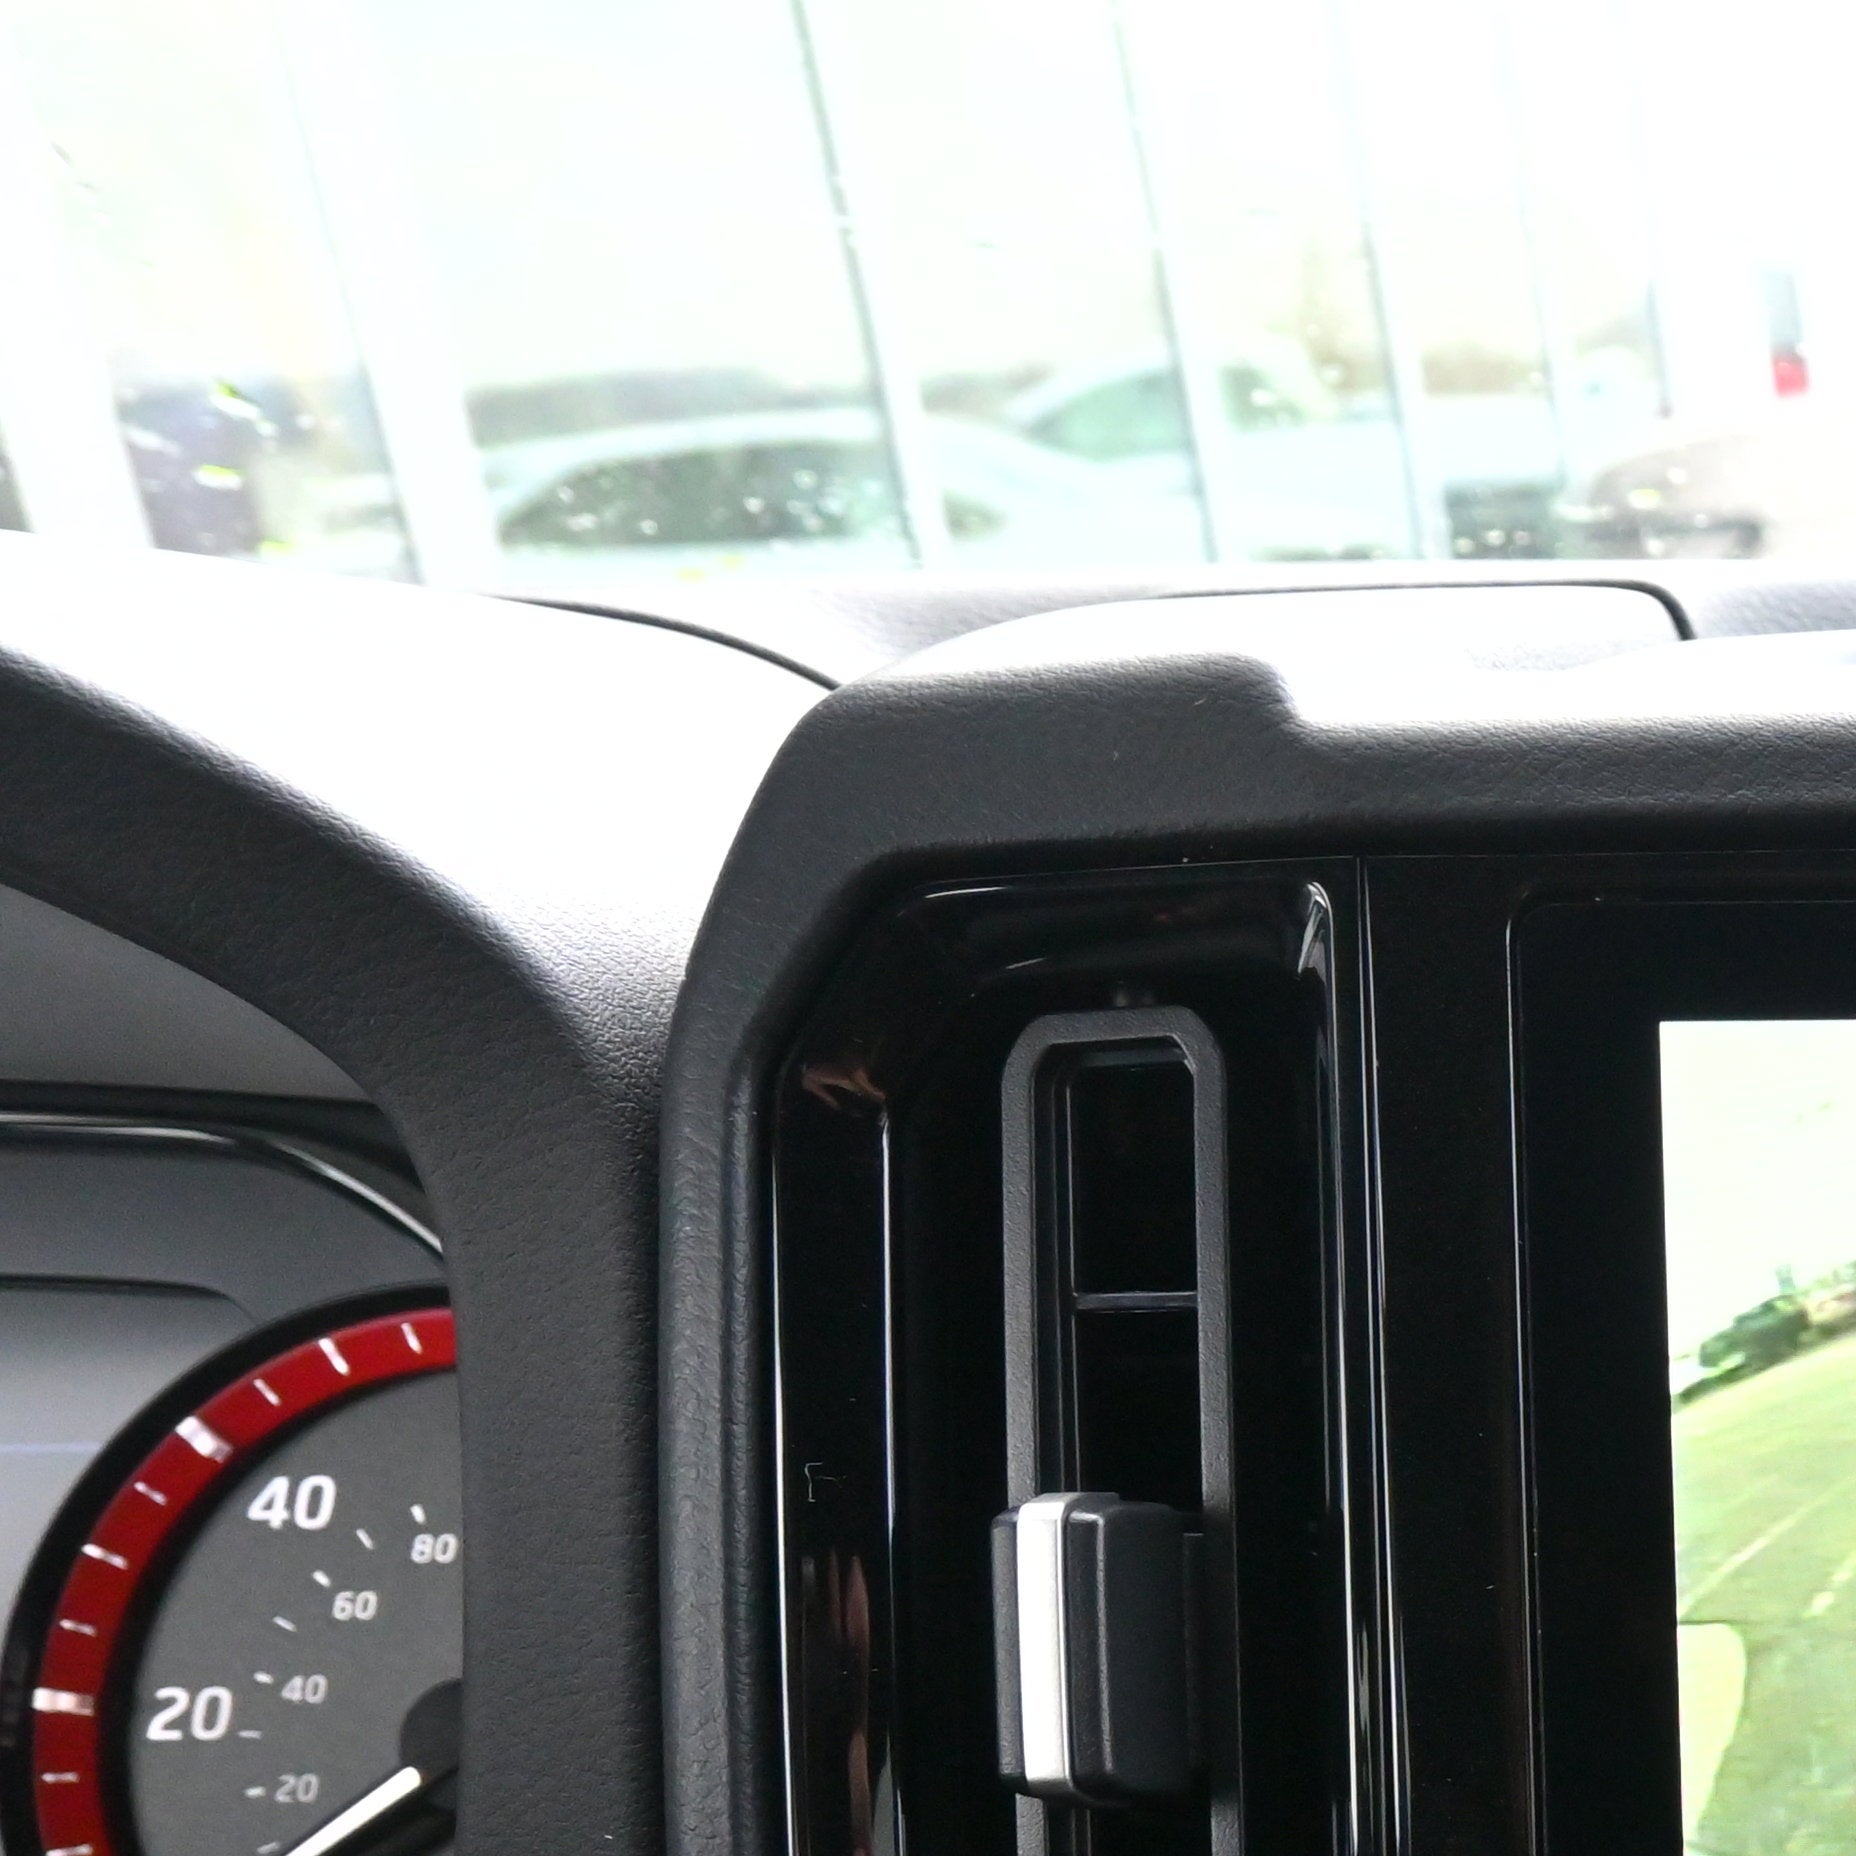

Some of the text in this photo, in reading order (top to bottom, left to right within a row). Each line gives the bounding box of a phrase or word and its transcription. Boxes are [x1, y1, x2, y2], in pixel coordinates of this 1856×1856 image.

[247, 1474, 337, 1530] 40
[410, 1533, 458, 1564] 80
[333, 1590, 378, 1622] 60
[281, 1674, 328, 1704] 40
[146, 1686, 233, 1741] 20
[274, 1773, 319, 1803] 20
